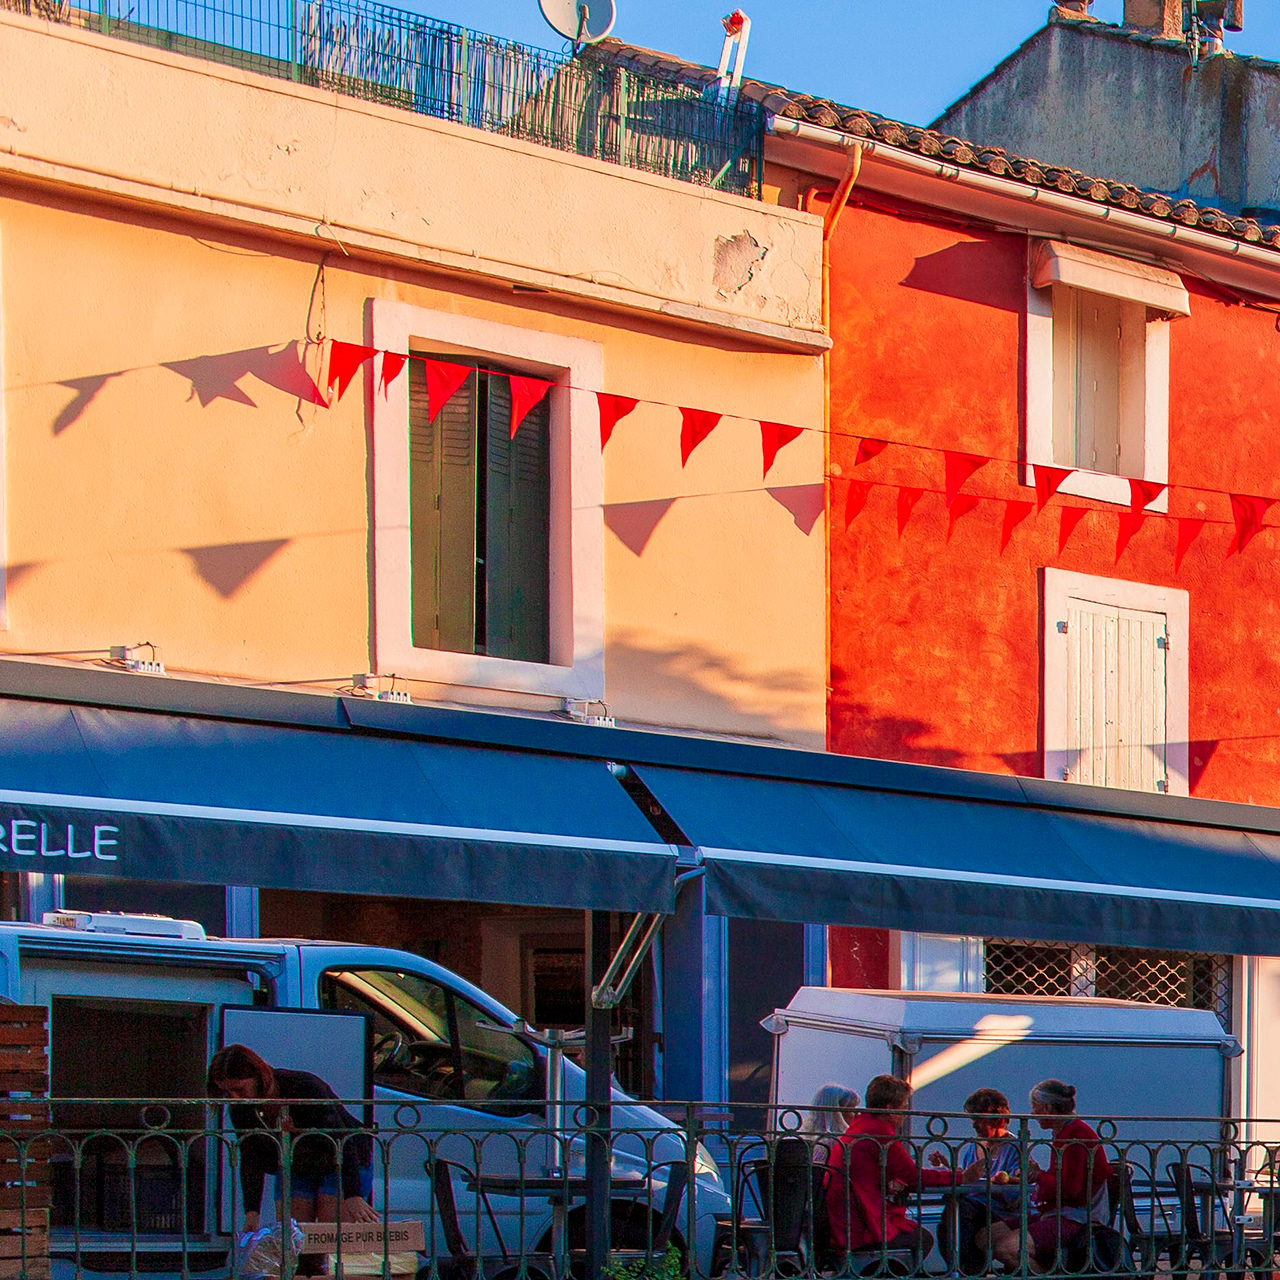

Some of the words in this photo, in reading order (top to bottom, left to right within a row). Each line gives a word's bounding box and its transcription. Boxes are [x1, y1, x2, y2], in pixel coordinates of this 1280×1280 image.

[307, 1231, 354, 1244] FROMGE
[355, 1231, 374, 1243] PUR
[376, 1230, 410, 1242] BEBIS
